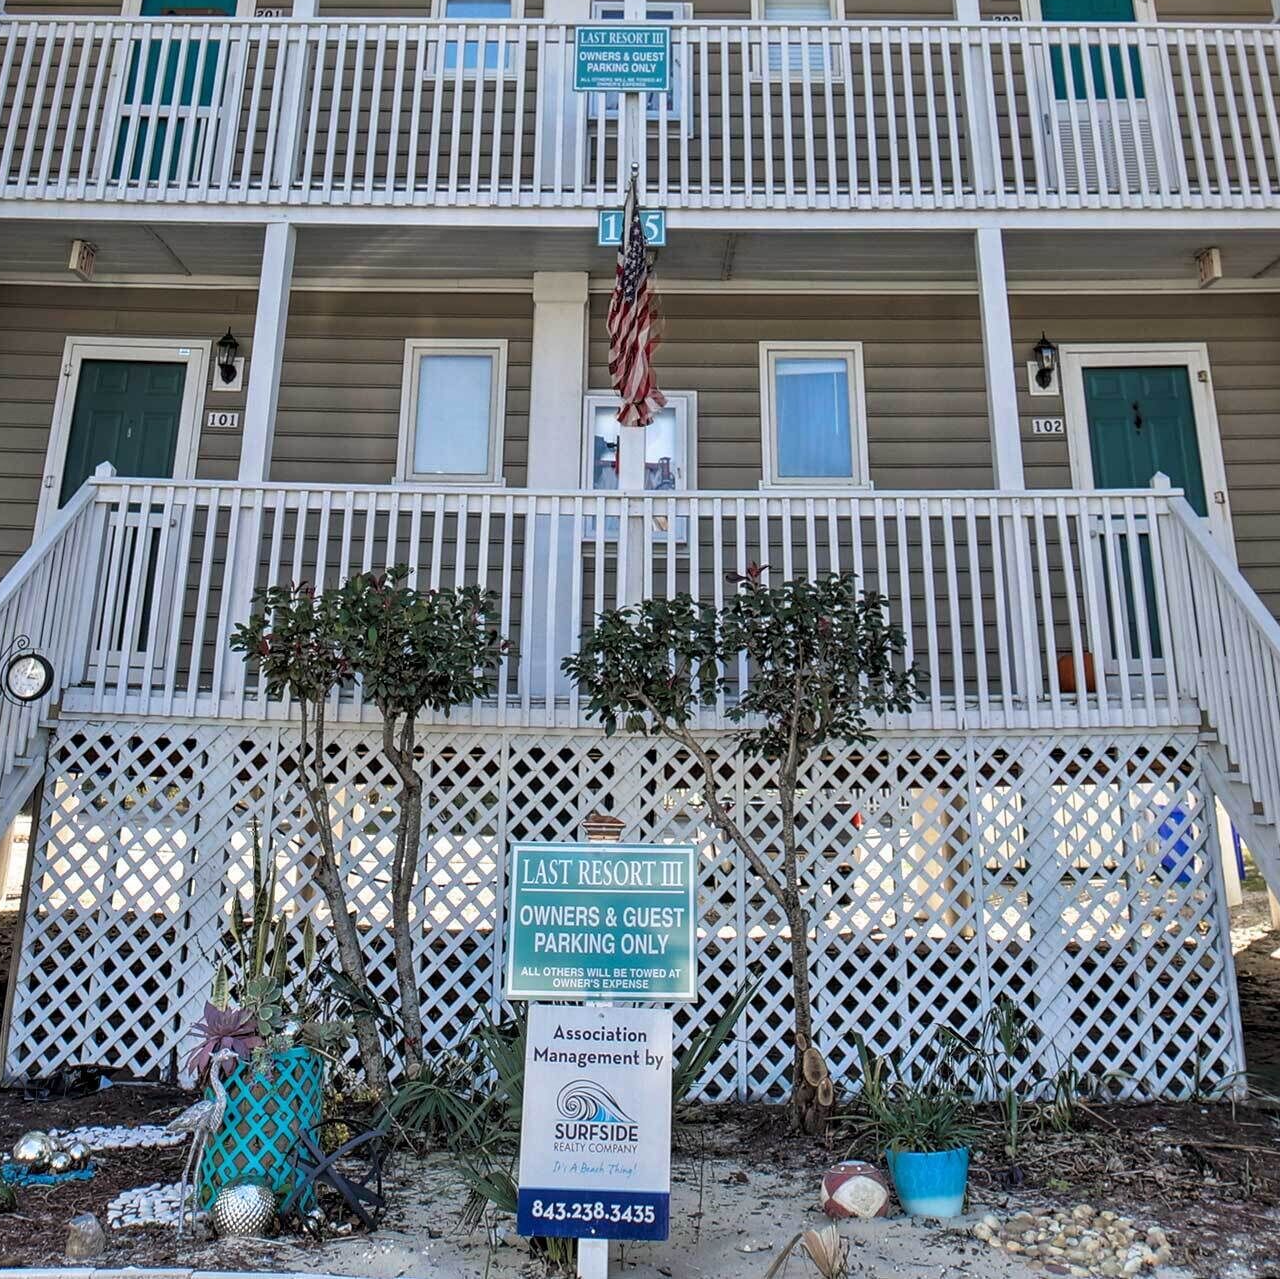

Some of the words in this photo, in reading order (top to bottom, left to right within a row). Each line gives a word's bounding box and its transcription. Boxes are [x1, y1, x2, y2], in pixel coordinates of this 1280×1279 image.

[581, 32, 607, 44] LAST
[610, 32, 650, 44] RESORT
[652, 32, 664, 44] III
[580, 52, 620, 61] OWNERS
[624, 52, 629, 61] &
[632, 52, 664, 62] GUEST
[587, 63, 629, 73] PARKING
[632, 63, 656, 73] ONLY
[210, 414, 235, 426] 101
[1035, 420, 1062, 432] 102
[522, 859, 573, 885] LAST
[578, 860, 656, 886] RESORT
[660, 861, 684, 887] III
[520, 905, 600, 926] OWNERS
[606, 907, 617, 927] &
[623, 907, 684, 928] GUEST
[534, 932, 615, 954] PARKING
[621, 934, 669, 955] ONLY
[521, 967, 540, 976] ALL
[543, 967, 584, 977] OTHERS
[587, 968, 610, 977] WILL
[614, 968, 627, 978] BE
[630, 968, 666, 978] TOWED
[669, 969, 681, 978] AT
[553, 978, 600, 988] OWNER'S
[602, 979, 648, 989] EXPENSE
[553, 1025, 647, 1042] Association
[533, 1046, 640, 1068] Management
[645, 1049, 663, 1070] by
[555, 1123, 638, 1142] SURFSIDE
[553, 1142, 585, 1152] REALTY
[588, 1144, 638, 1153] COMPANY
[531, 1200, 655, 1223] 843.238.3435
